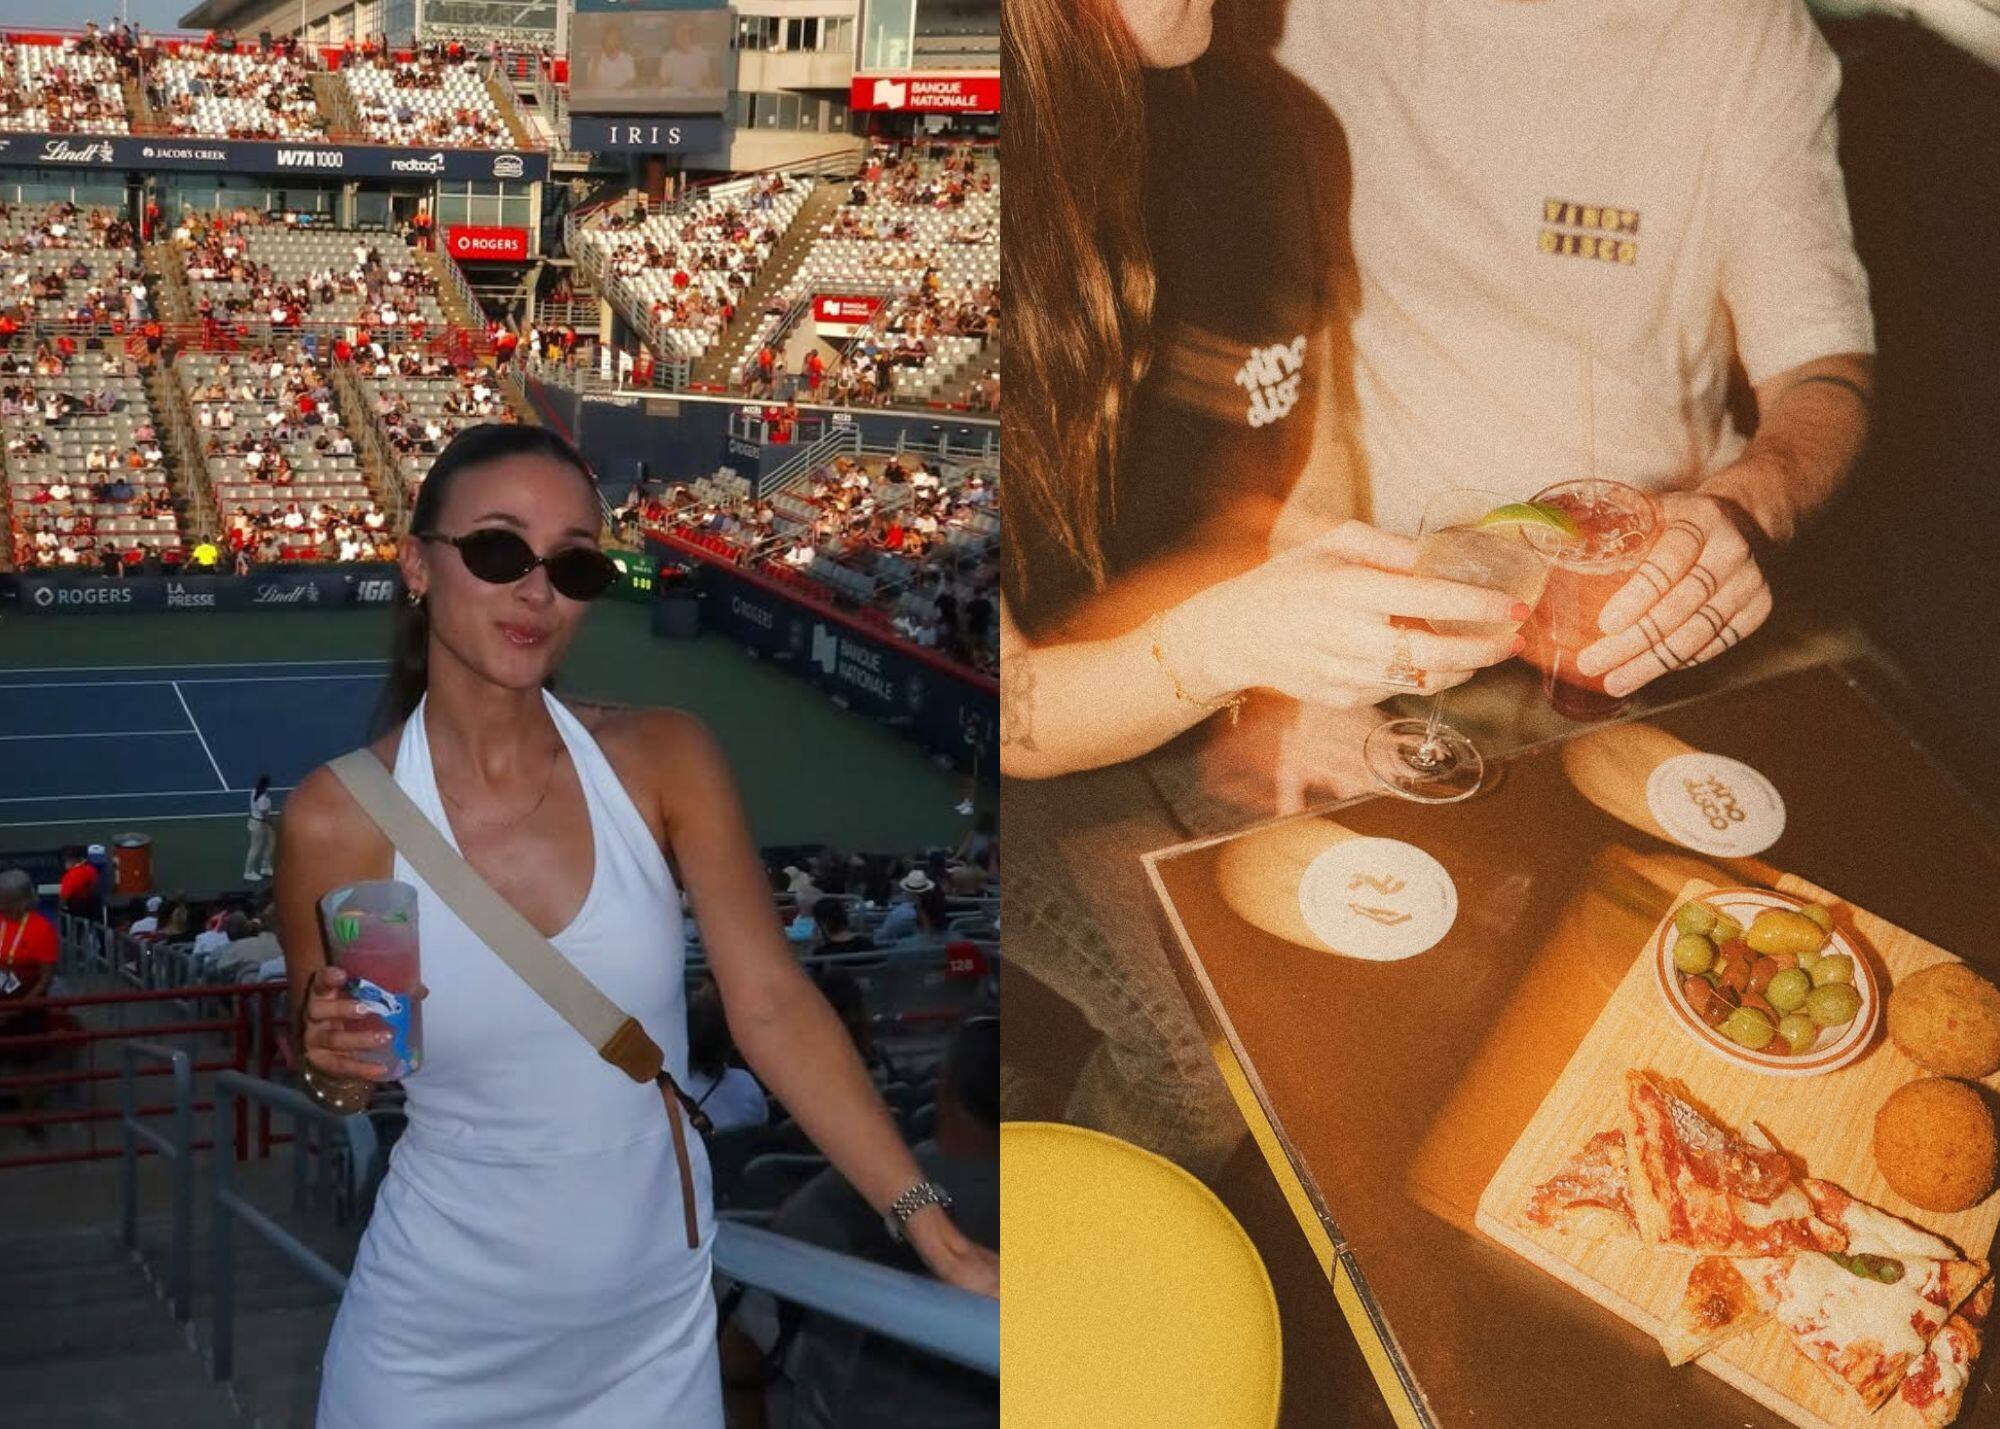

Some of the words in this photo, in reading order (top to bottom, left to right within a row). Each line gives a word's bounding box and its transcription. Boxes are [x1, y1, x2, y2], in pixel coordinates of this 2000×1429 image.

[911, 81, 961, 94] BANQUE
[910, 94, 978, 106] NATIONALE
[610, 126, 681, 144] IRIS
[39, 140, 99, 162] Lindt
[195, 150, 227, 160] CREEK
[277, 150, 315, 167] WTA
[316, 151, 344, 168] 1000
[472, 238, 519, 250] ROGERS
[167, 583, 185, 594] LA
[358, 580, 394, 602] IGA
[58, 588, 133, 604] ROGERS
[167, 594, 216, 606] PRESSE
